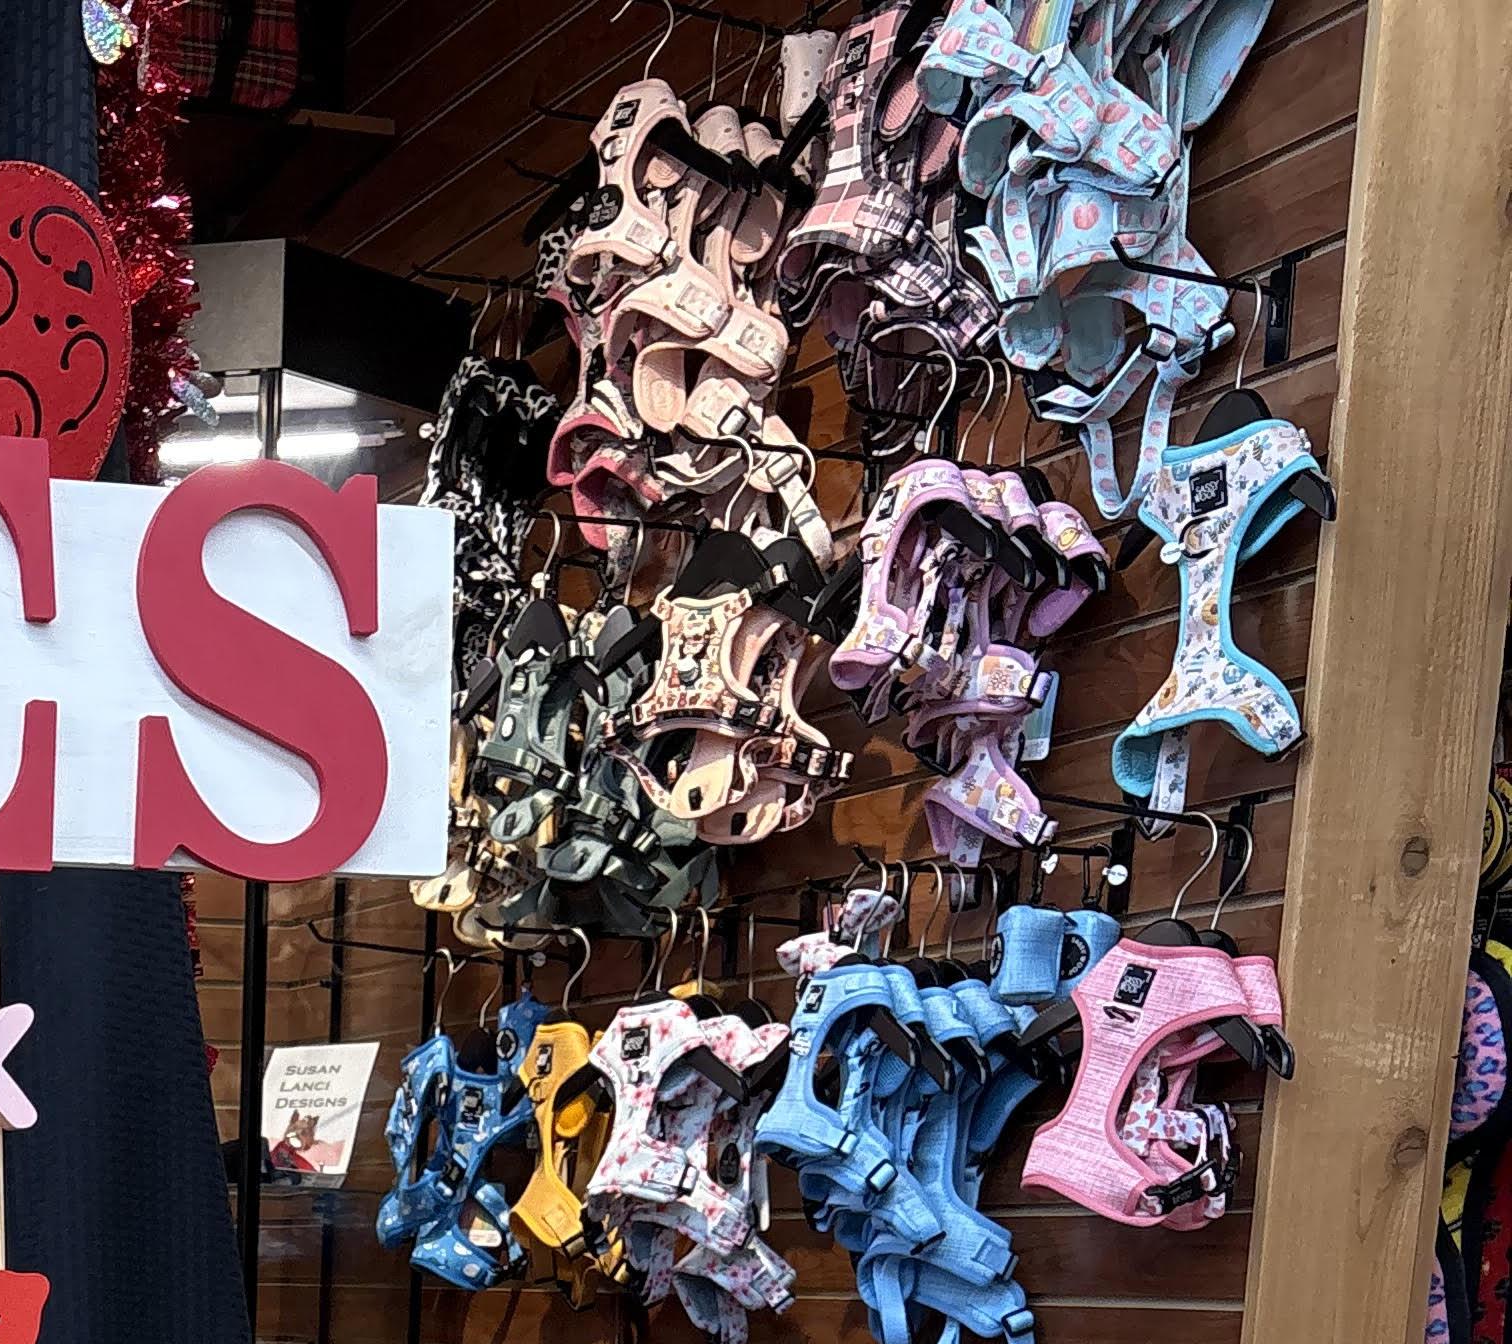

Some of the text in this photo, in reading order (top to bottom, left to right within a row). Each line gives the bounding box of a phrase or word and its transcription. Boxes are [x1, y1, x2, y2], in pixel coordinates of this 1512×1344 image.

[285, 1065, 342, 1076] SUSAN
[279, 1081, 331, 1092] LANCI
[275, 1097, 348, 1109] DESIGNS
